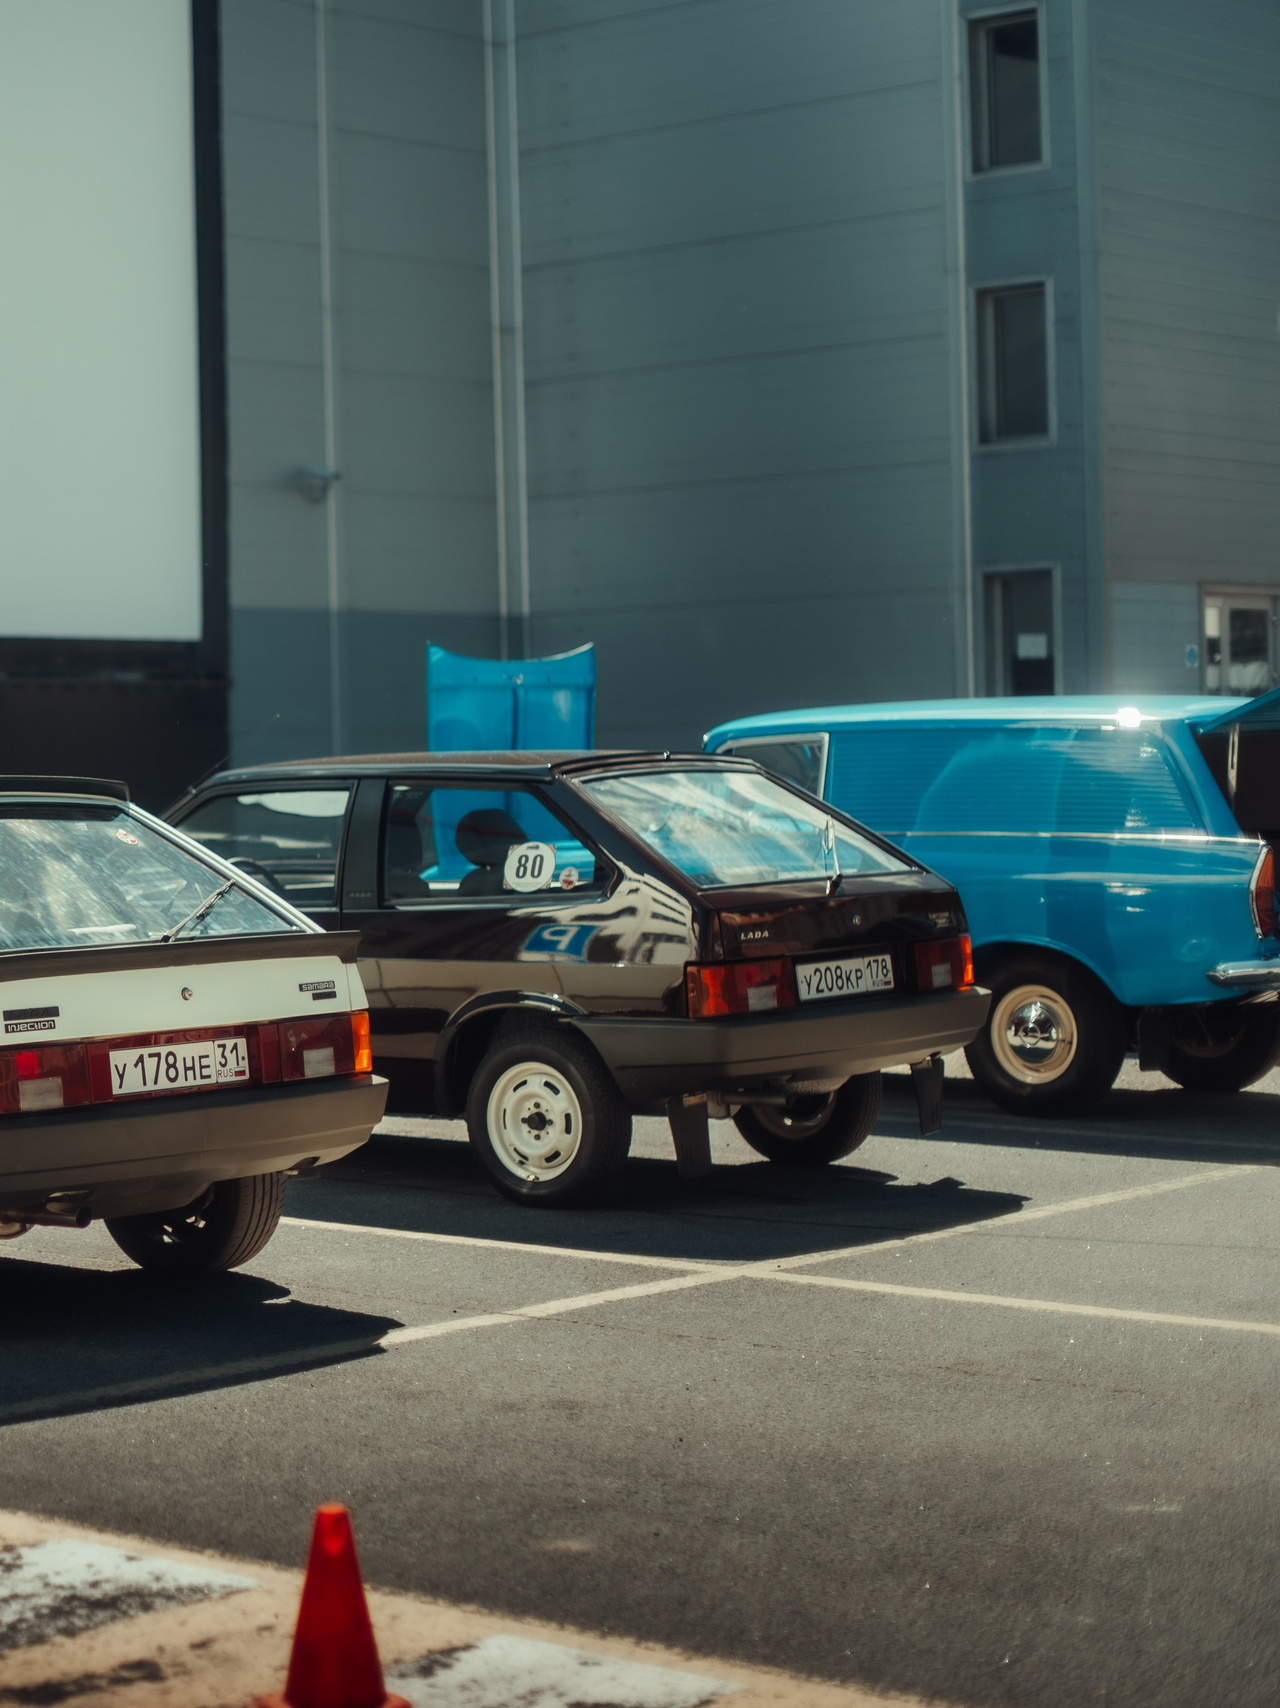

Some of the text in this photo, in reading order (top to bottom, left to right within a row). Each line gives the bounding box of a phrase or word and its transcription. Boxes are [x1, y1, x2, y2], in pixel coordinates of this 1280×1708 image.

[515, 854, 545, 879] 80
[740, 930, 769, 941] LADA
[866, 958, 889, 979] 178
[217, 1042, 240, 1069] 31
[217, 1068, 234, 1078] RUS
